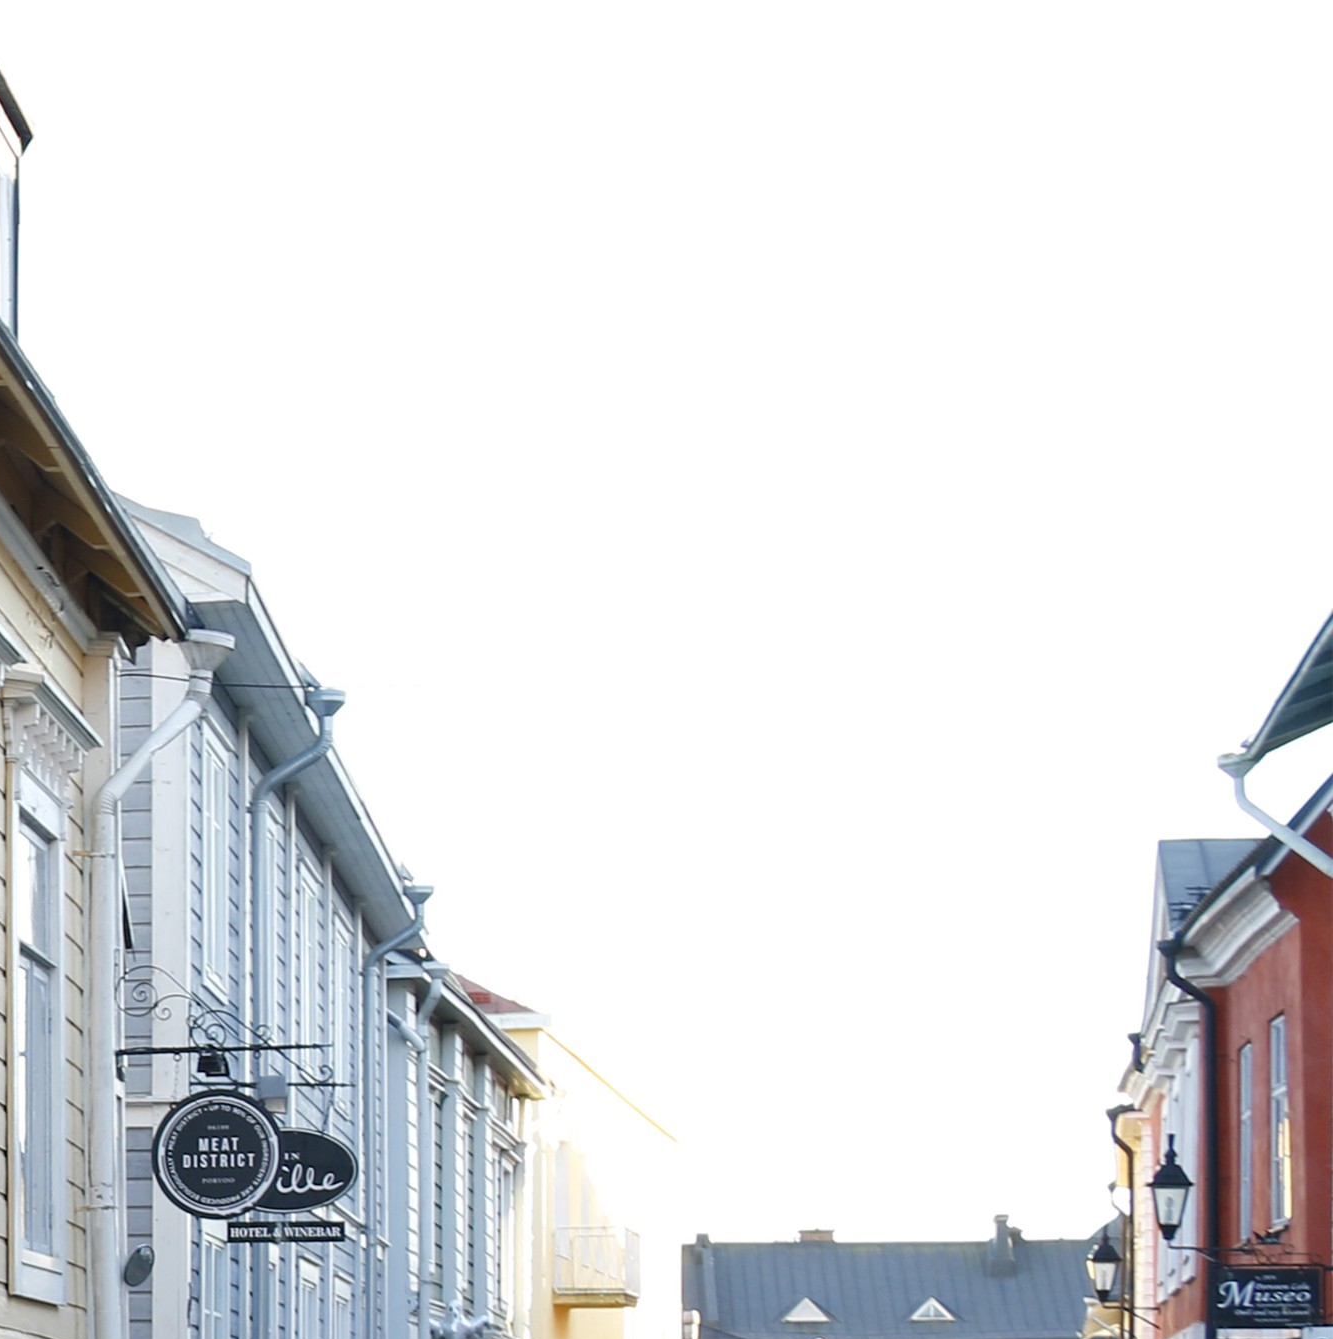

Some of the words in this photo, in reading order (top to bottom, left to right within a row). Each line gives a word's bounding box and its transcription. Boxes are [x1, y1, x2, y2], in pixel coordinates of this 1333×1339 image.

[198, 1137, 239, 1152] MEAT
[182, 1153, 255, 1168] DISTRICT
[276, 1163, 344, 1193] ille
[230, 1227, 271, 1238] HOTEL
[273, 1227, 282, 1238] &
[283, 1226, 342, 1238] WINEBAR
[1216, 1280, 1312, 1308] Museo
